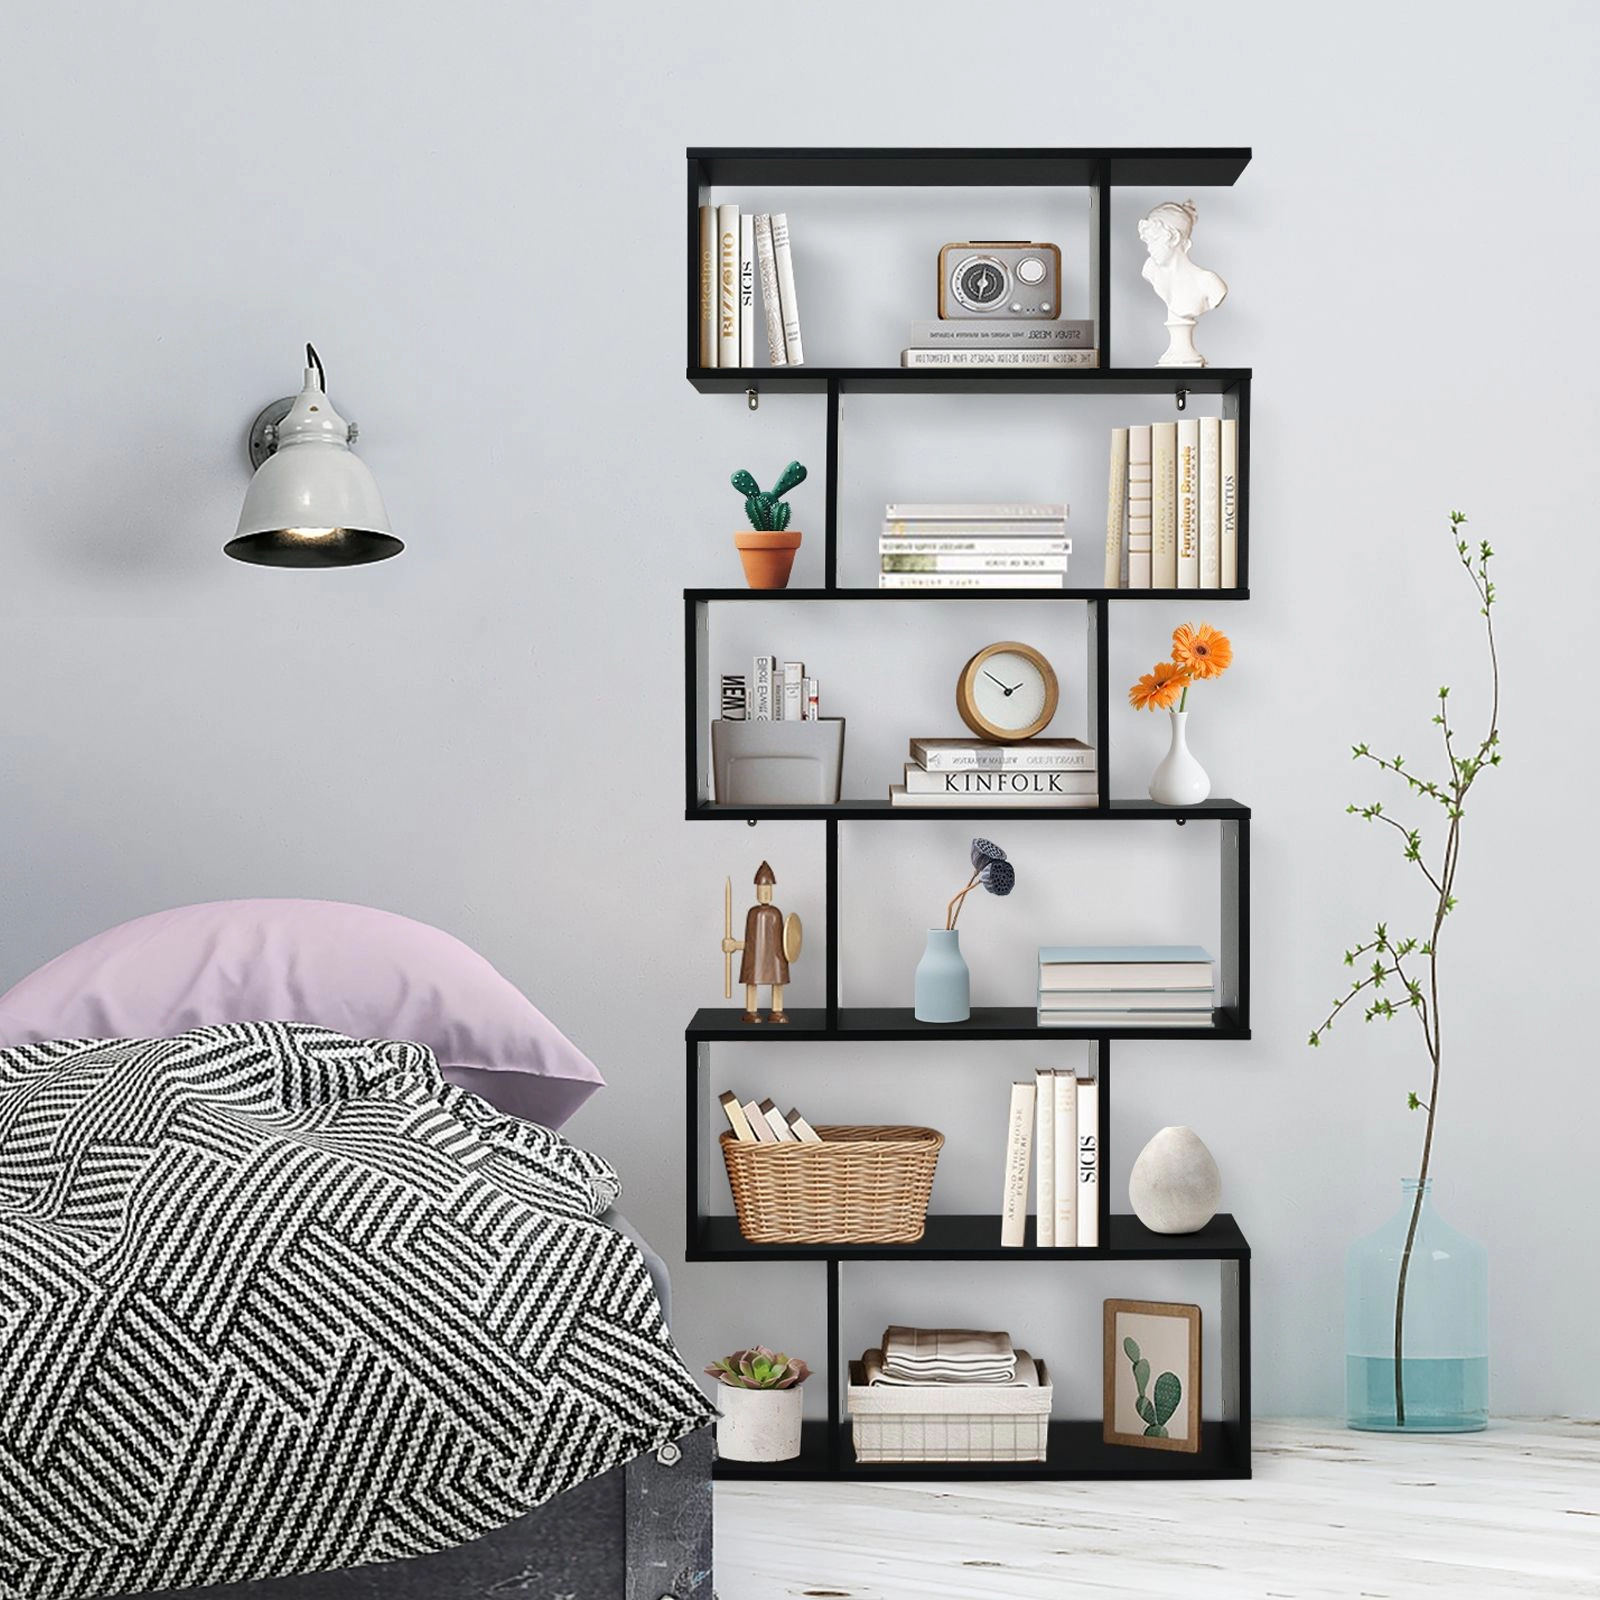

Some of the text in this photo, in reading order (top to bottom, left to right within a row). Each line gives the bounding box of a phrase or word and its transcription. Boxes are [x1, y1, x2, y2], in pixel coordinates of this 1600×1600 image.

[702, 250, 713, 321] arketipo
[743, 261, 752, 307] SICIS
[1180, 446, 1191, 558] Furniture Brands
[1225, 475, 1235, 533] TACITUS
[945, 773, 1064, 792] KINFOLK
[1017, 1134, 1028, 1196] FURNITURE
[1080, 1135, 1096, 1183] SICIS
[1008, 1174, 1017, 1221] AROUND
